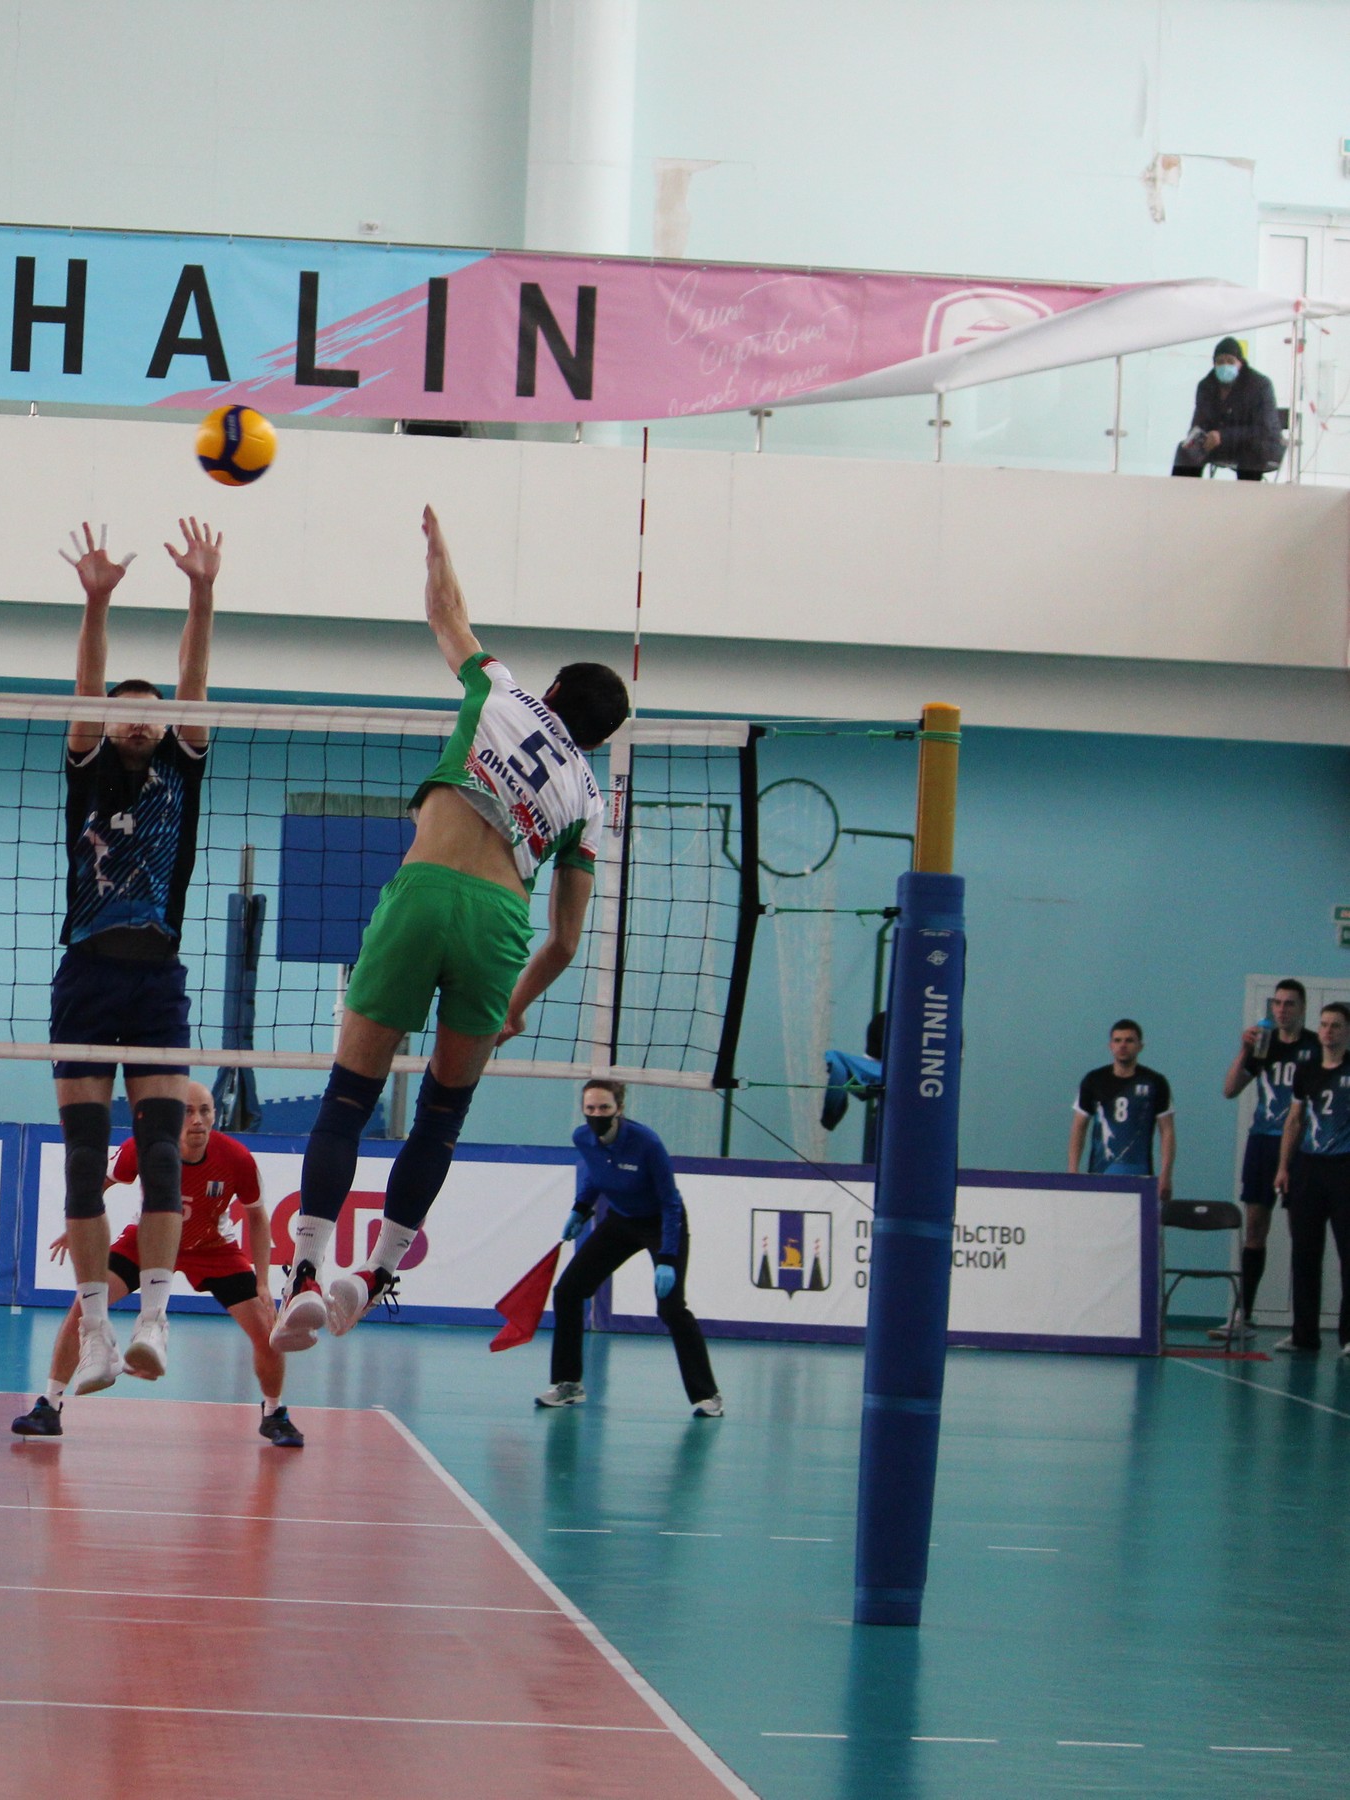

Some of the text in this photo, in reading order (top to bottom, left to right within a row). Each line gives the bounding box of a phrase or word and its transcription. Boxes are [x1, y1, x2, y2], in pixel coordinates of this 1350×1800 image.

[507, 730, 567, 794] 5
[919, 985, 948, 1098] JINLING
[1271, 1061, 1297, 1086] 10
[1114, 1096, 1129, 1122] 8
[1321, 1089, 1333, 1114] 2
